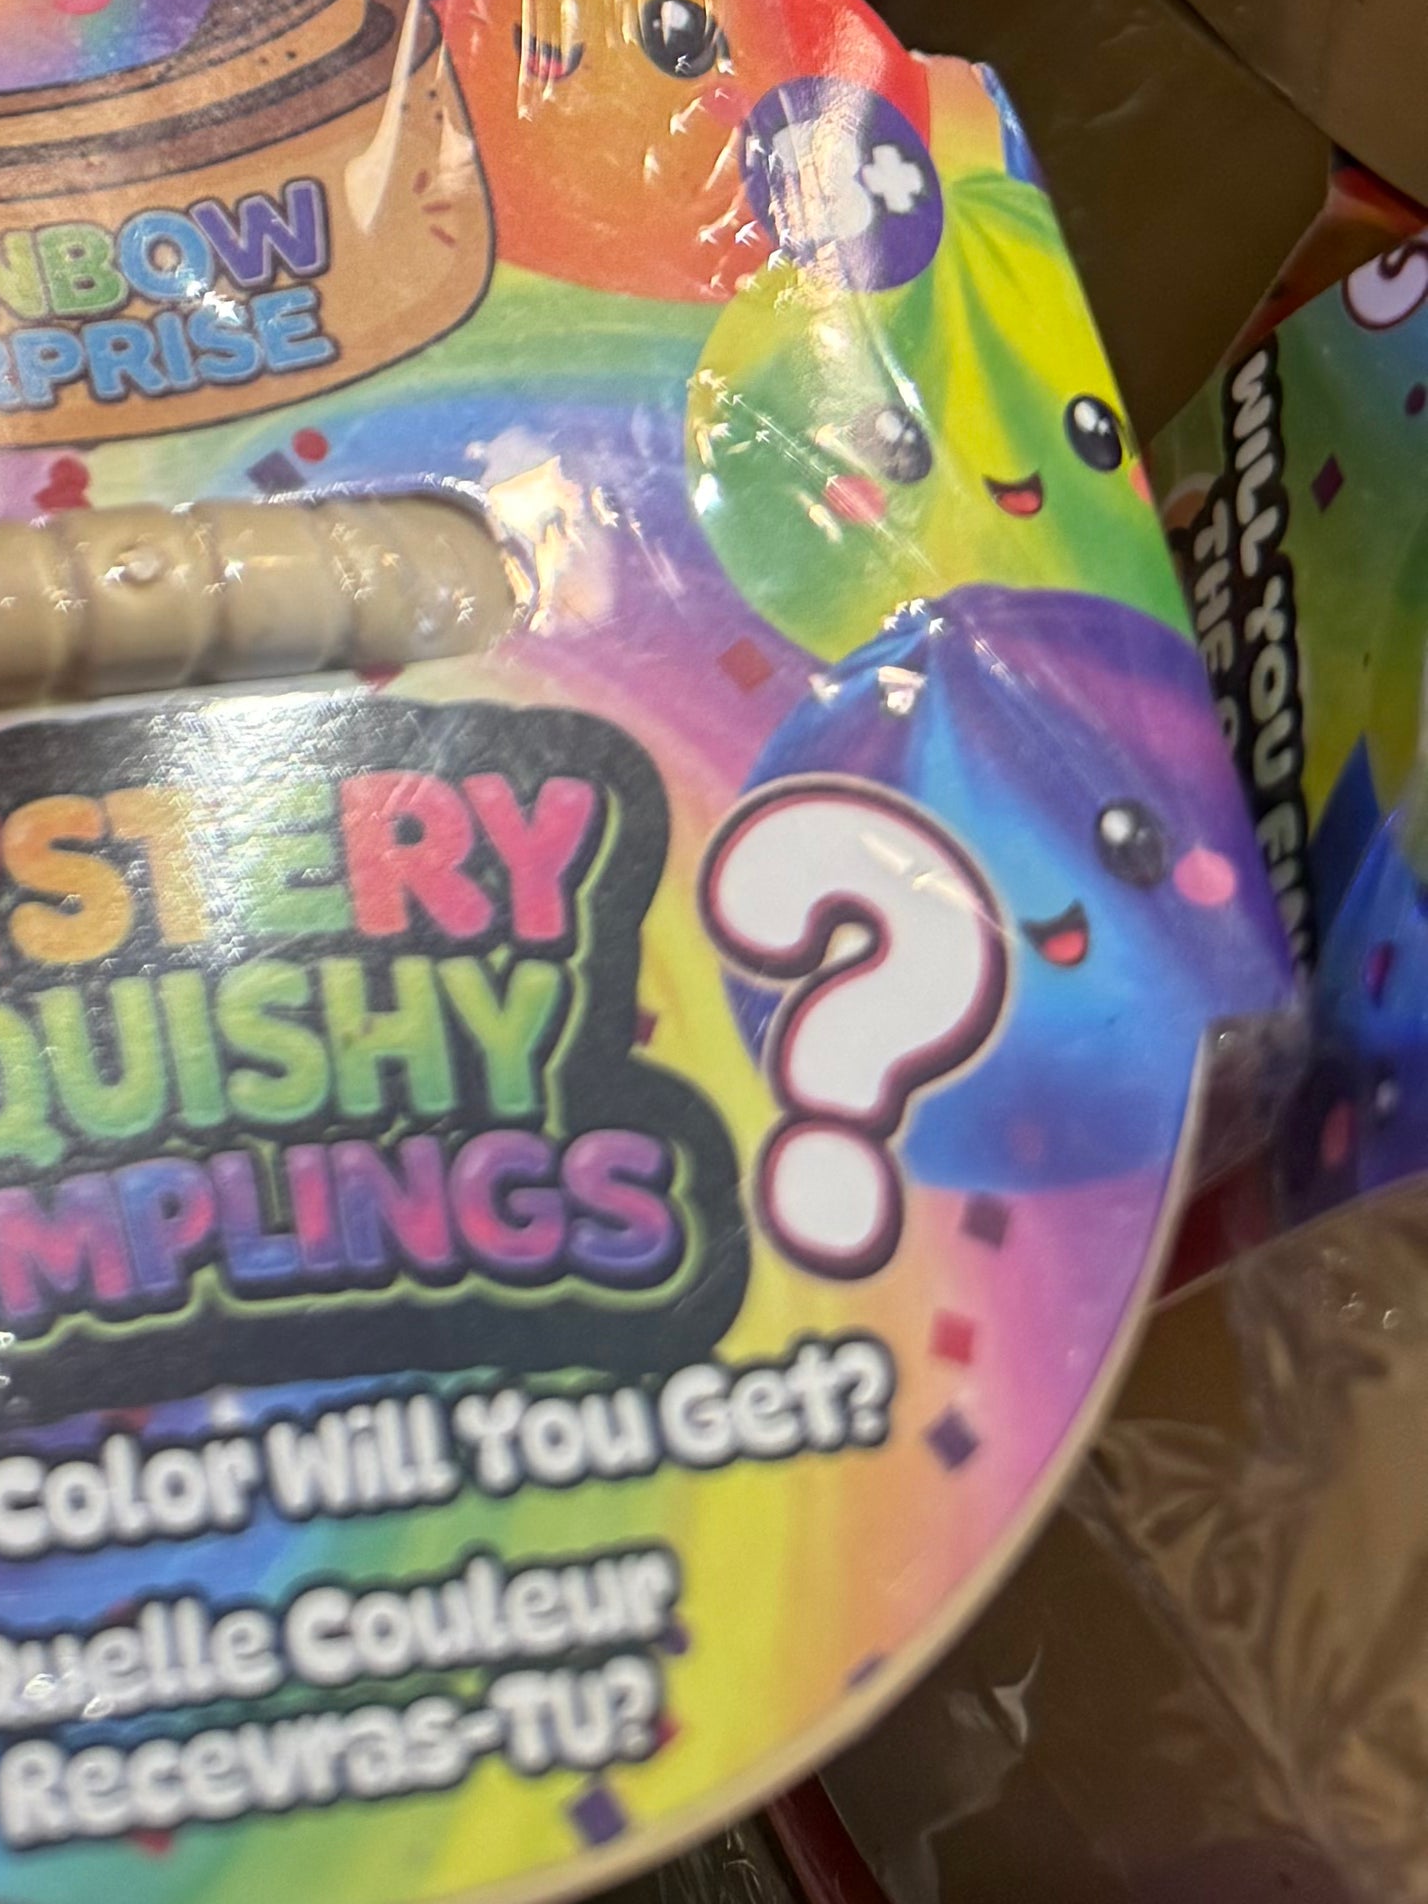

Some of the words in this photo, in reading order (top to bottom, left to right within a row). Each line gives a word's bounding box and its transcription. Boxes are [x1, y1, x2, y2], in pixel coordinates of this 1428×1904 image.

[1234, 350, 1278, 576] WILL
[1192, 499, 1235, 672] THE
[1246, 577, 1295, 789] YOU
[269, 1397, 454, 1510] Will
[457, 1388, 655, 1490] You
[665, 1341, 891, 1455] Get?
[289, 1556, 675, 1668] Couleur
